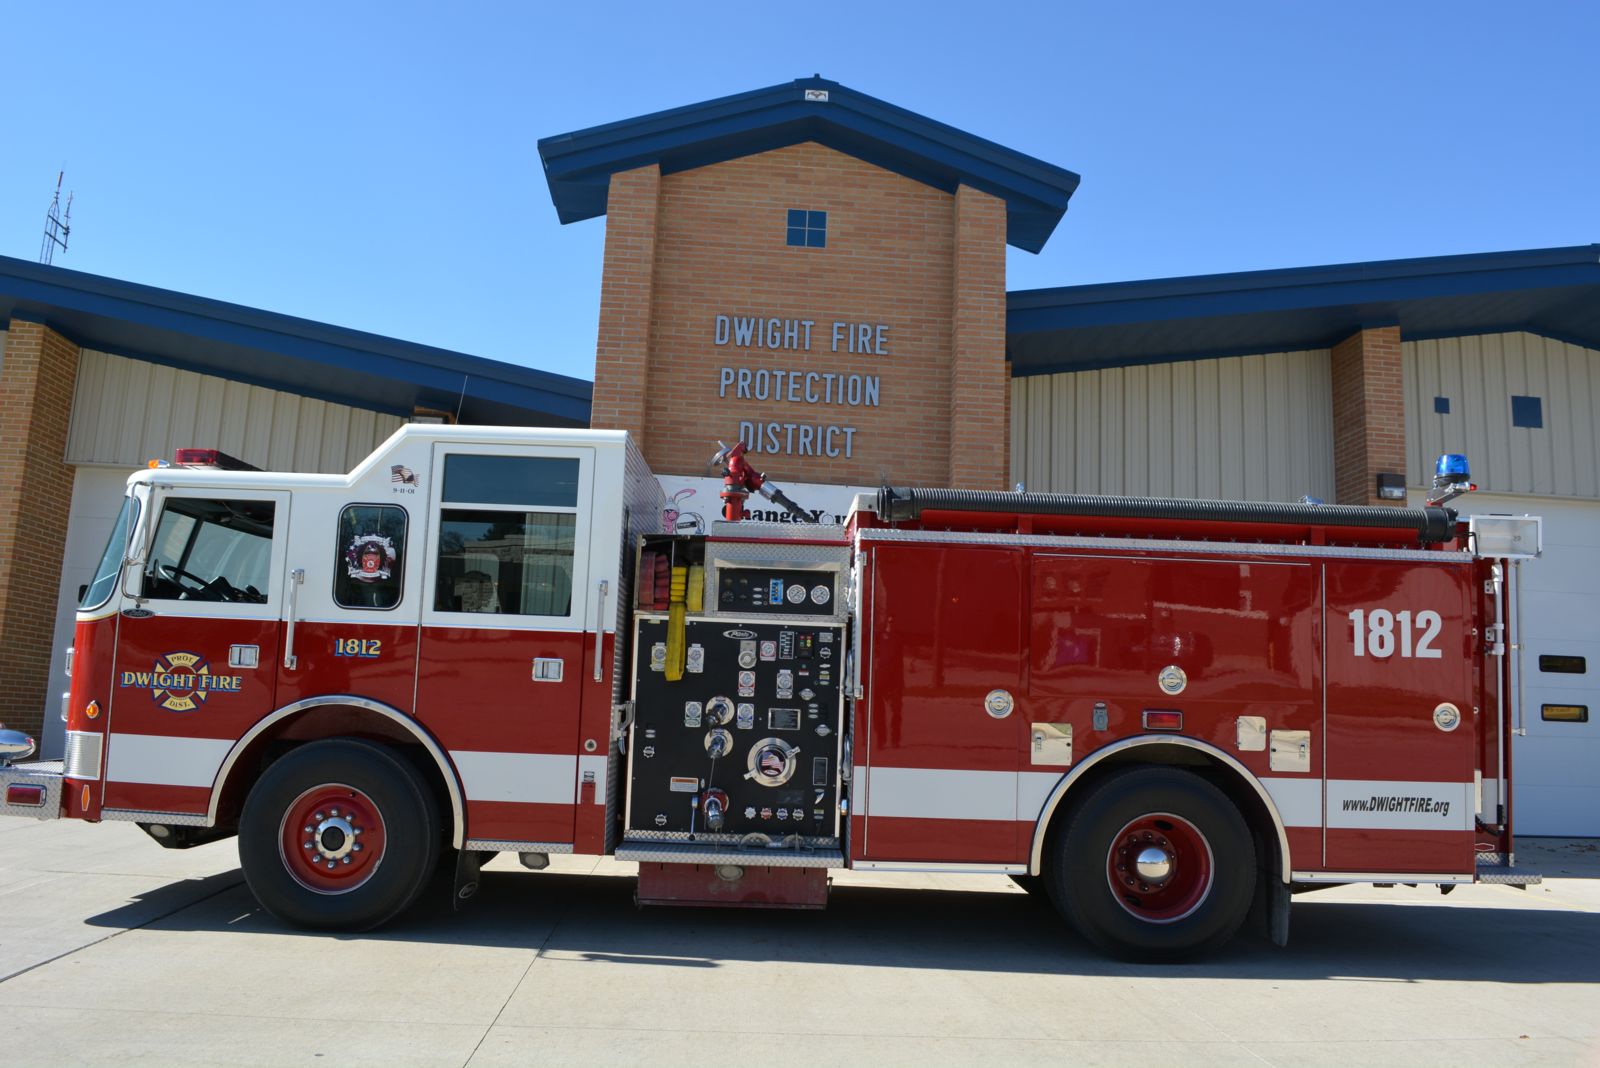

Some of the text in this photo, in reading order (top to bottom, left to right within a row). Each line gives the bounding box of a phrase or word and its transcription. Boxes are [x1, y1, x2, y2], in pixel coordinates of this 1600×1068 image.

[714, 314, 889, 355] DWIGHT FIRE
[719, 367, 880, 407] PROTECTION
[739, 421, 857, 459] DISTRICT
[721, 505, 804, 524] hange
[1348, 608, 1442, 659] 1812
[335, 637, 382, 658] 1812
[120, 671, 242, 693] DWIGHT FIRE
[169, 699, 191, 708] DIST.
[1342, 796, 1450, 817] www.DWIGHTFIRE.org
